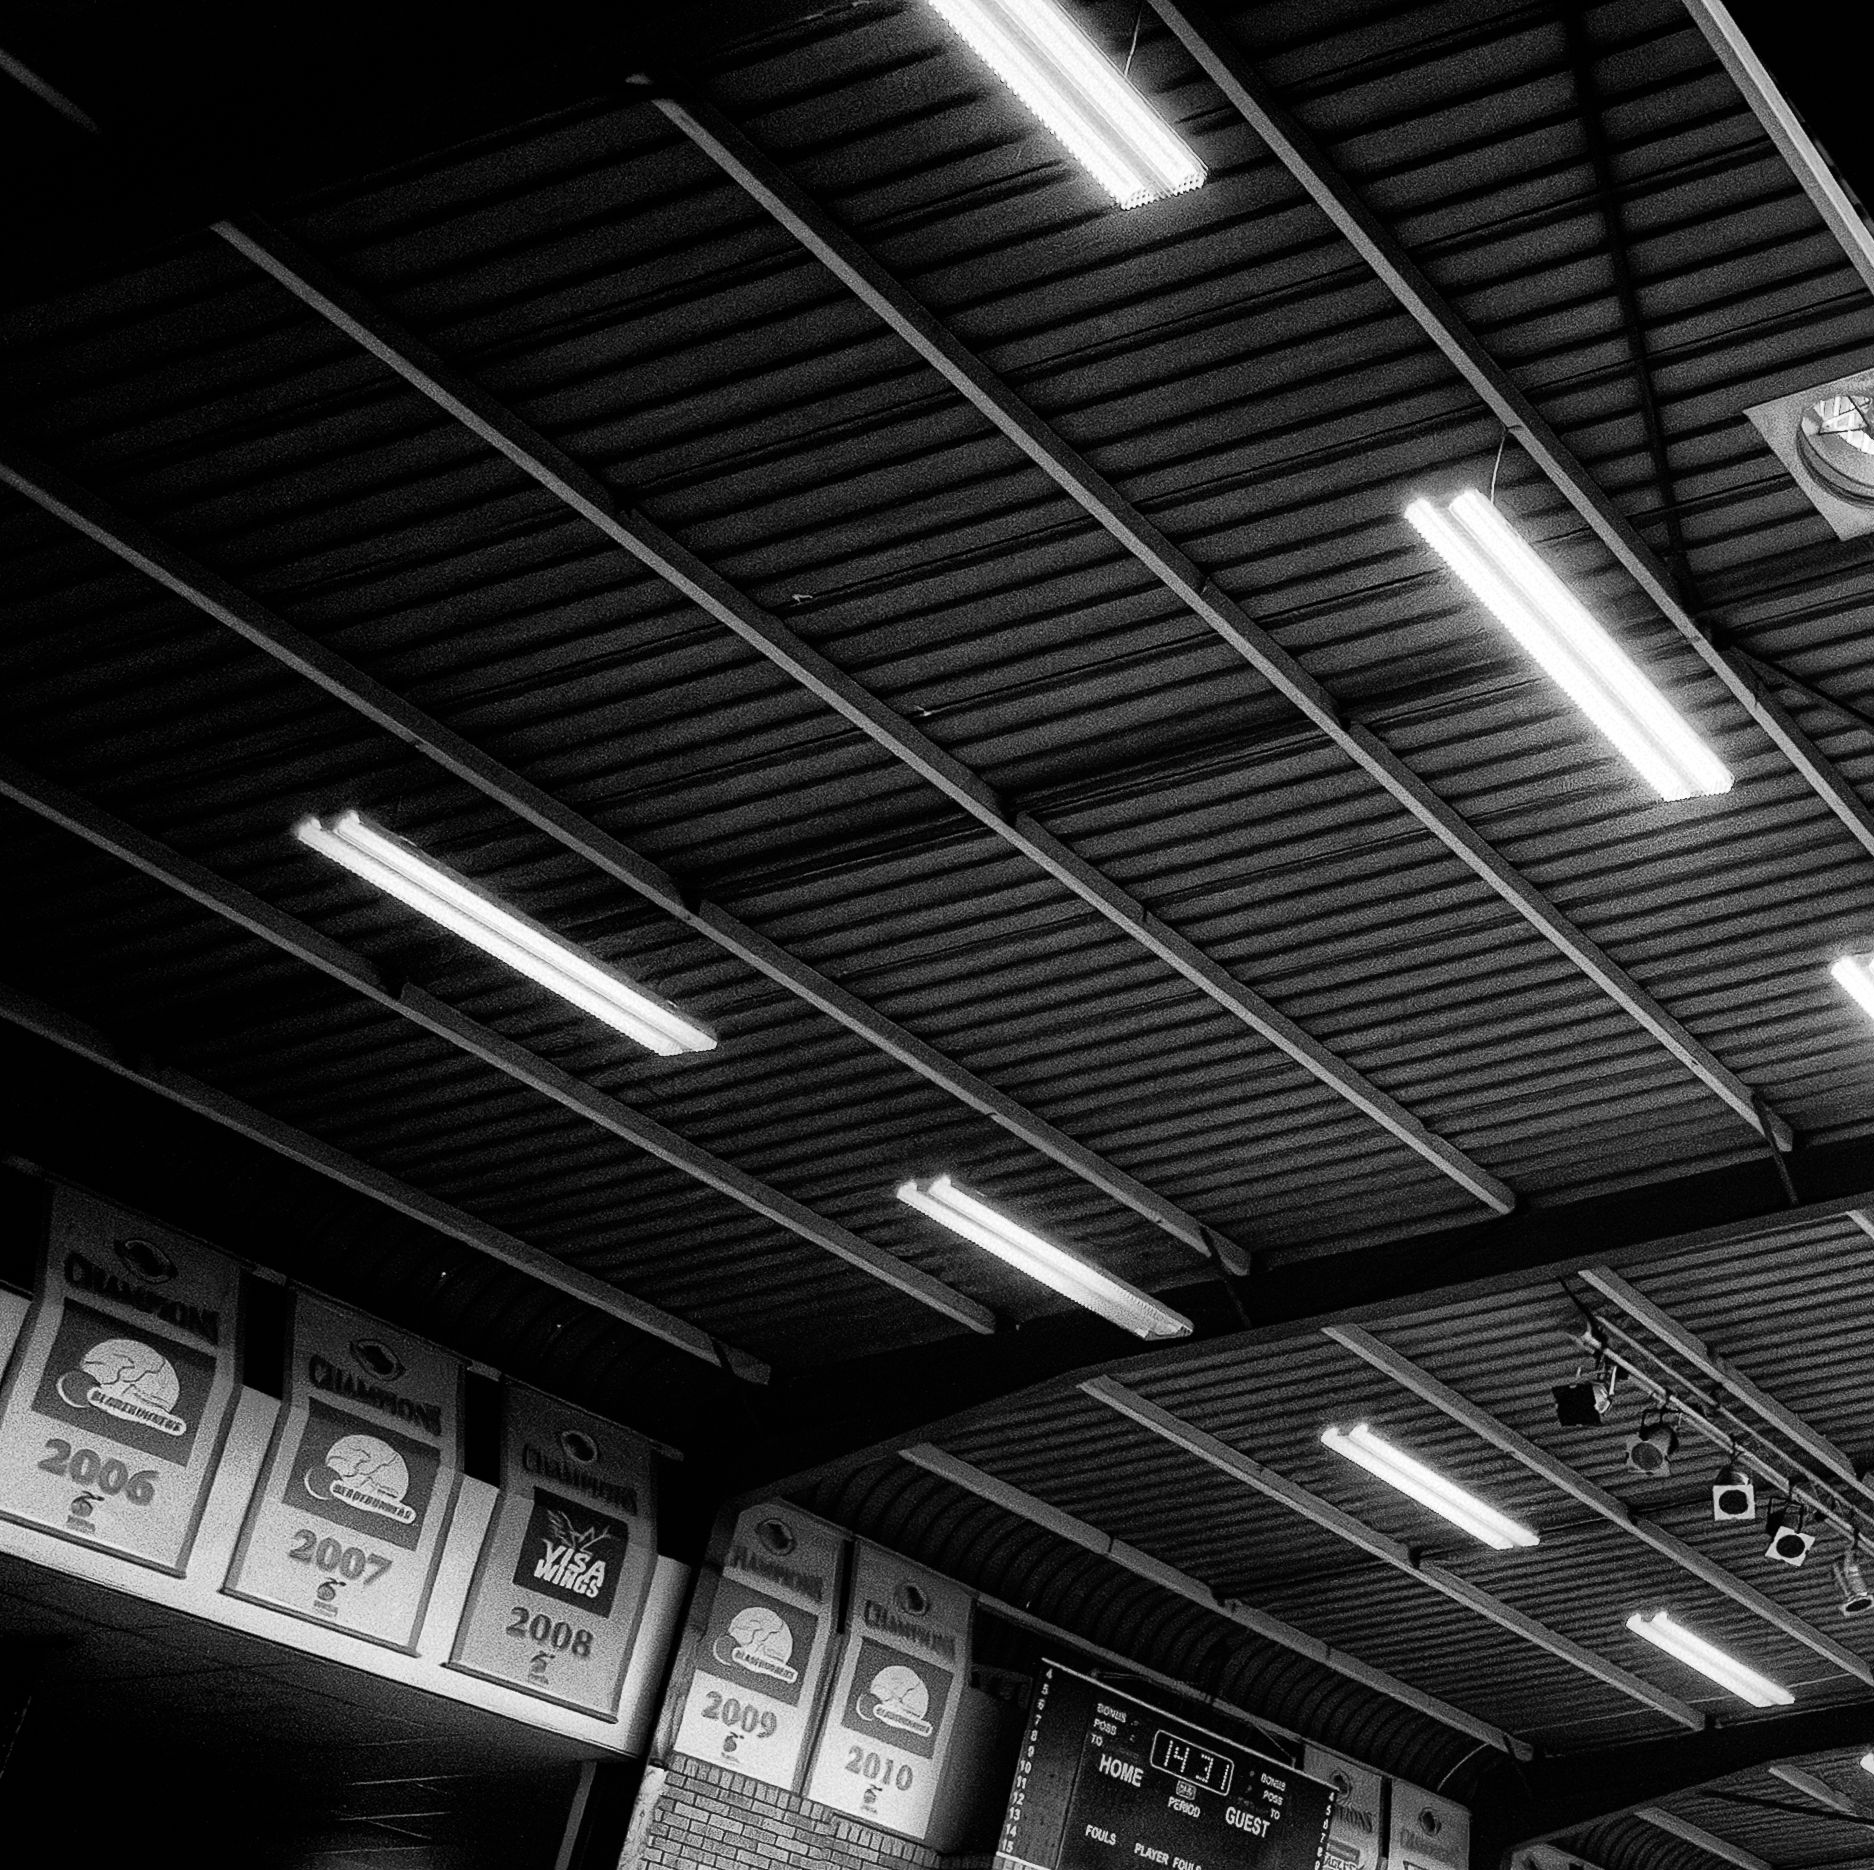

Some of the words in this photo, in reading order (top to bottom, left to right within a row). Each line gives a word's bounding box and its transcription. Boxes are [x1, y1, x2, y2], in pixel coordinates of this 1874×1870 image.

[38, 1437, 159, 1507] 2006
[289, 1529, 392, 1586] 2007
[542, 1538, 606, 1587] VISA
[534, 1558, 599, 1598] WINGS
[506, 1607, 593, 1658] 2008
[1046, 1668, 1053, 1680] 4
[1041, 1683, 1049, 1695] 5
[702, 1691, 777, 1739] 2009
[1035, 1714, 1042, 1726] 7
[1093, 1718, 1117, 1735] POSS
[1030, 1729, 1038, 1741] 8
[1090, 1733, 1103, 1747] TO
[845, 1746, 913, 1791] 2010
[1020, 1760, 1031, 1774] 10
[1099, 1754, 1144, 1787] HOME
[1016, 1776, 1027, 1789] 11
[1012, 1792, 1025, 1805] 12
[1009, 1807, 1021, 1821] 13
[1168, 1796, 1201, 1818] PERIOD
[1270, 1808, 1280, 1820] TO
[1326, 1805, 1332, 1815] 5
[1225, 1806, 1270, 1838] GUEST
[1006, 1824, 1017, 1837] 14
[1085, 1824, 1117, 1846] FOULS
[1320, 1833, 1326, 1843] 7
[1002, 1839, 1014, 1853] 15
[1134, 1842, 1169, 1866] PLAYER
